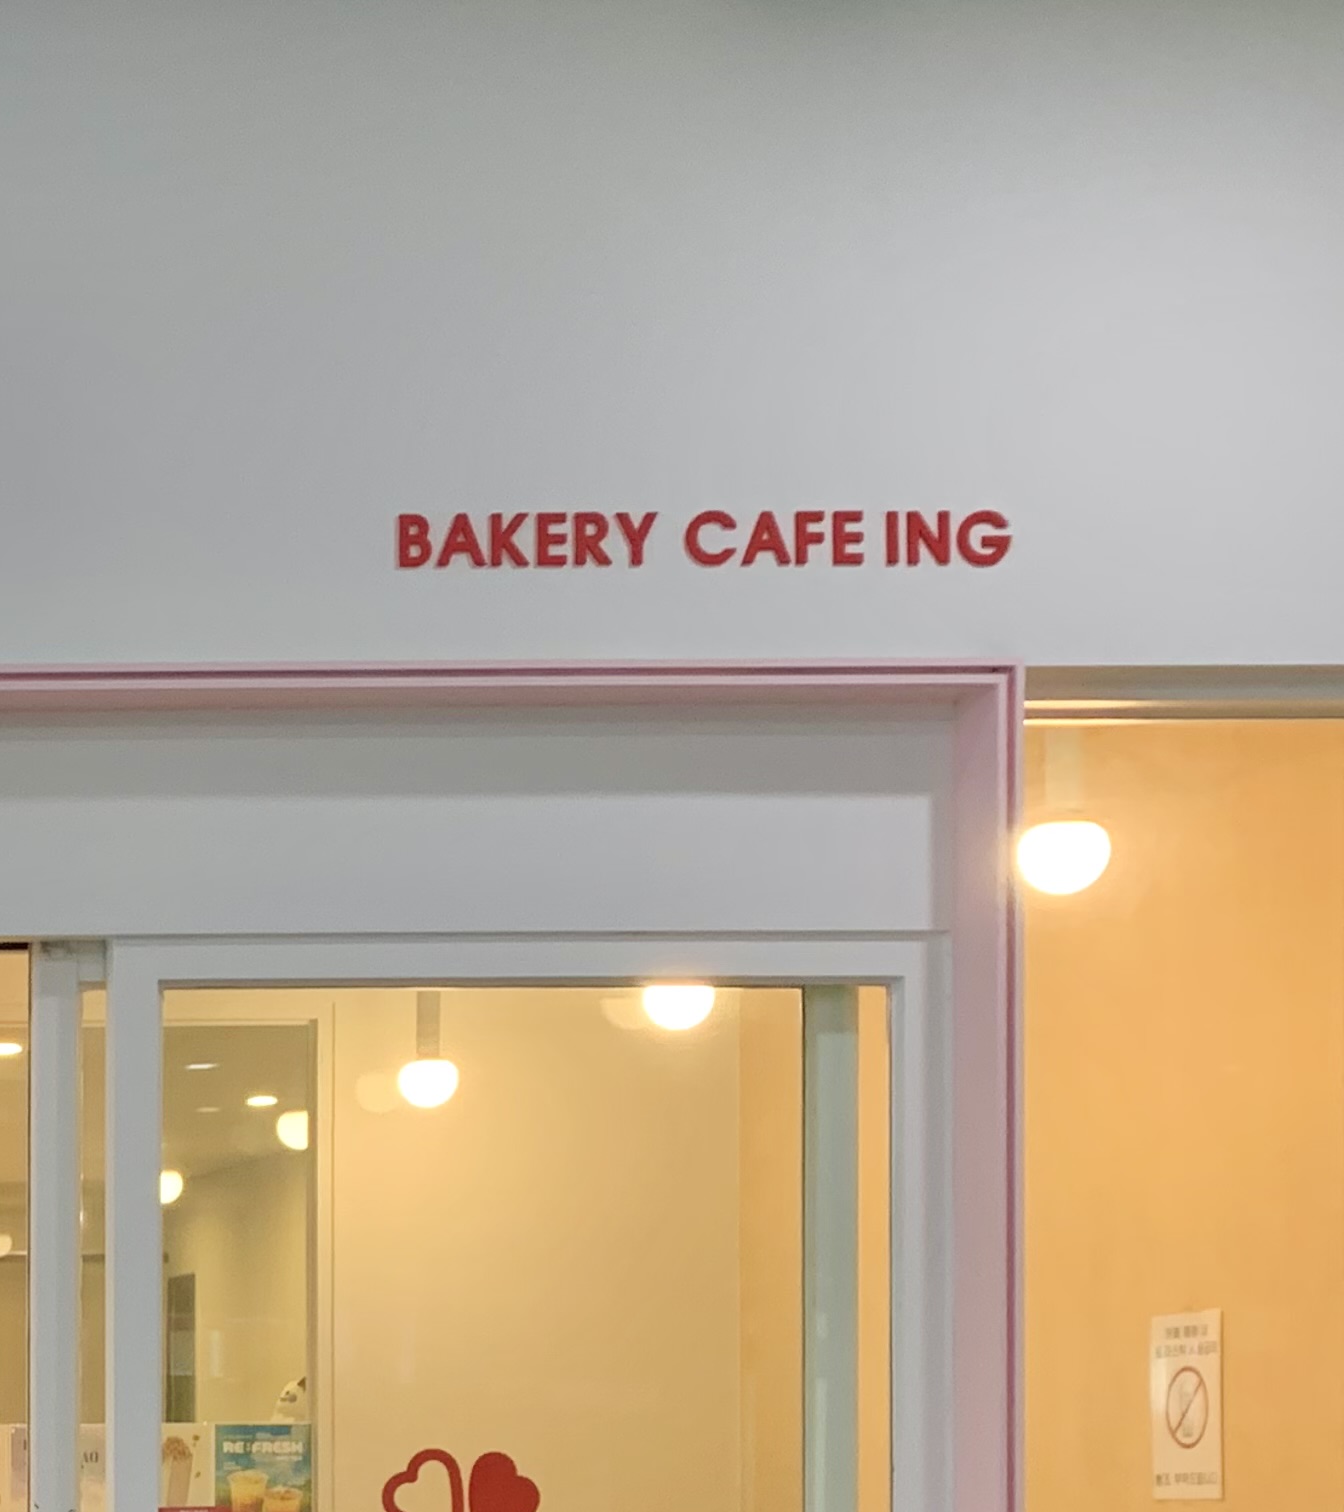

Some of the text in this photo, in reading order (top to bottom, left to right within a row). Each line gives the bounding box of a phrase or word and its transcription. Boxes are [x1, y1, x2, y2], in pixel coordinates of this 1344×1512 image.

[395, 510, 1014, 569] BAKERY CAFE ING
